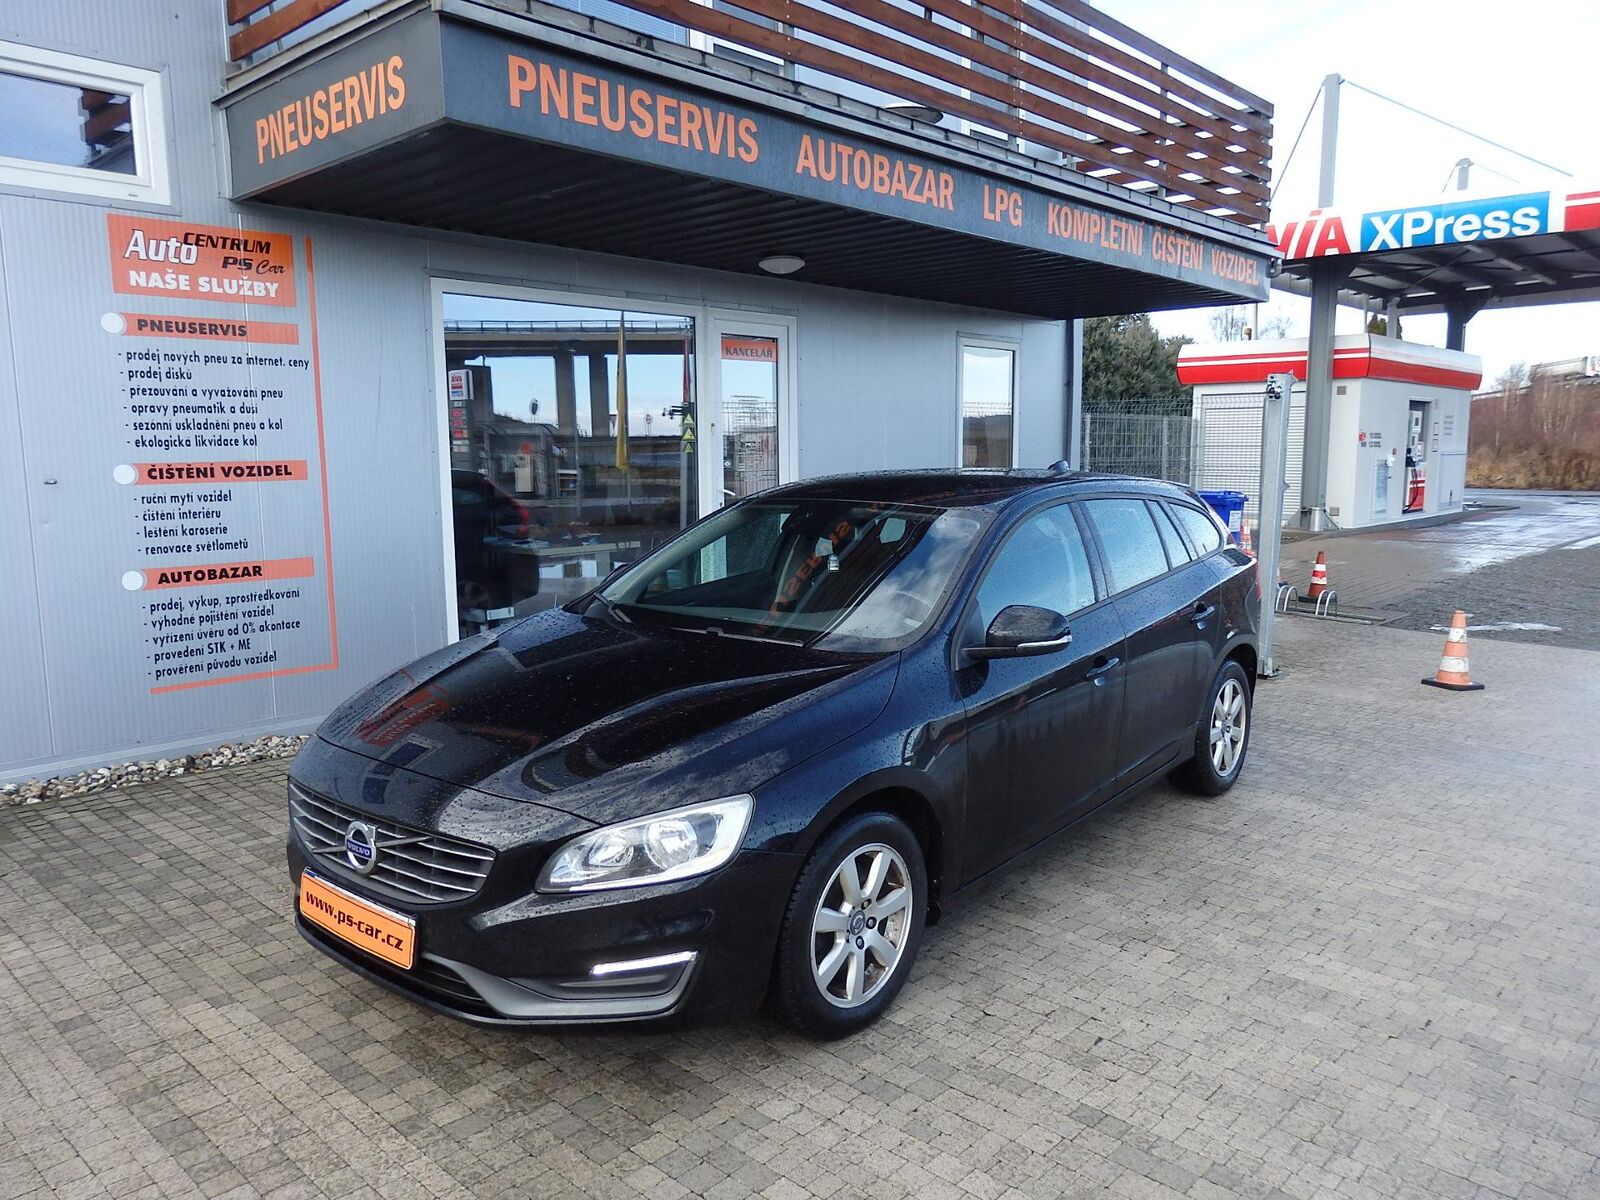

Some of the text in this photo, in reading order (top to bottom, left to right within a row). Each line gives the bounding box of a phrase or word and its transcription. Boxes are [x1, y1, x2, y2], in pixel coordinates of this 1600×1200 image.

[255, 55, 406, 165] PNEUSERVIS
[507, 54, 1259, 286] PNEUSERVIS AUTOBAZAR LPG KOMPLETNÍ ČIŠTĚNÍ VOZIDEL
[1368, 206, 1541, 252] XPress
[123, 229, 271, 265] Auto CENTRUM
[222, 255, 286, 275] PS Car
[129, 268, 279, 298] NAŠE SLUŽBY
[137, 318, 248, 337] PNEUSERVIS
[126, 350, 310, 371] prodej nových pneu za internet. ceny
[725, 346, 773, 358] KANCELÁŘ
[128, 369, 162, 383] prodej
[130, 385, 189, 399] přezouvání
[192, 387, 198, 397] a
[261, 389, 284, 401] pneu
[131, 404, 169, 417] opravy
[172, 402, 226, 417] pneumatik
[230, 404, 236, 414] a
[133, 418, 284, 433] sezónní uskladnění pneu a kol
[135, 434, 259, 451] ekologická likvidace kol
[147, 463, 293, 480] ČIŠTĚNÍ VOZIDEL
[141, 492, 167, 505] ruční
[197, 489, 233, 503] vozidel
[142, 508, 221, 522] čištění interiéru
[144, 524, 228, 539] leštění karoserie
[145, 538, 249, 556] renovace světlometů
[158, 565, 263, 585] AUTOBAZAR
[150, 588, 301, 616] prodej, výkup, zprostředkování
[151, 604, 275, 631] výhodné pojištění vozidel
[152, 618, 301, 647] vyřízení úvěru od 0% akontace
[154, 647, 205, 665] provedení
[207, 641, 227, 654] STK
[238, 638, 251, 650] ME
[155, 650, 278, 681] prověření původu vozidel
[347, 841, 371, 856] VOLVO
[306, 891, 404, 952] www.ps-car.cz
